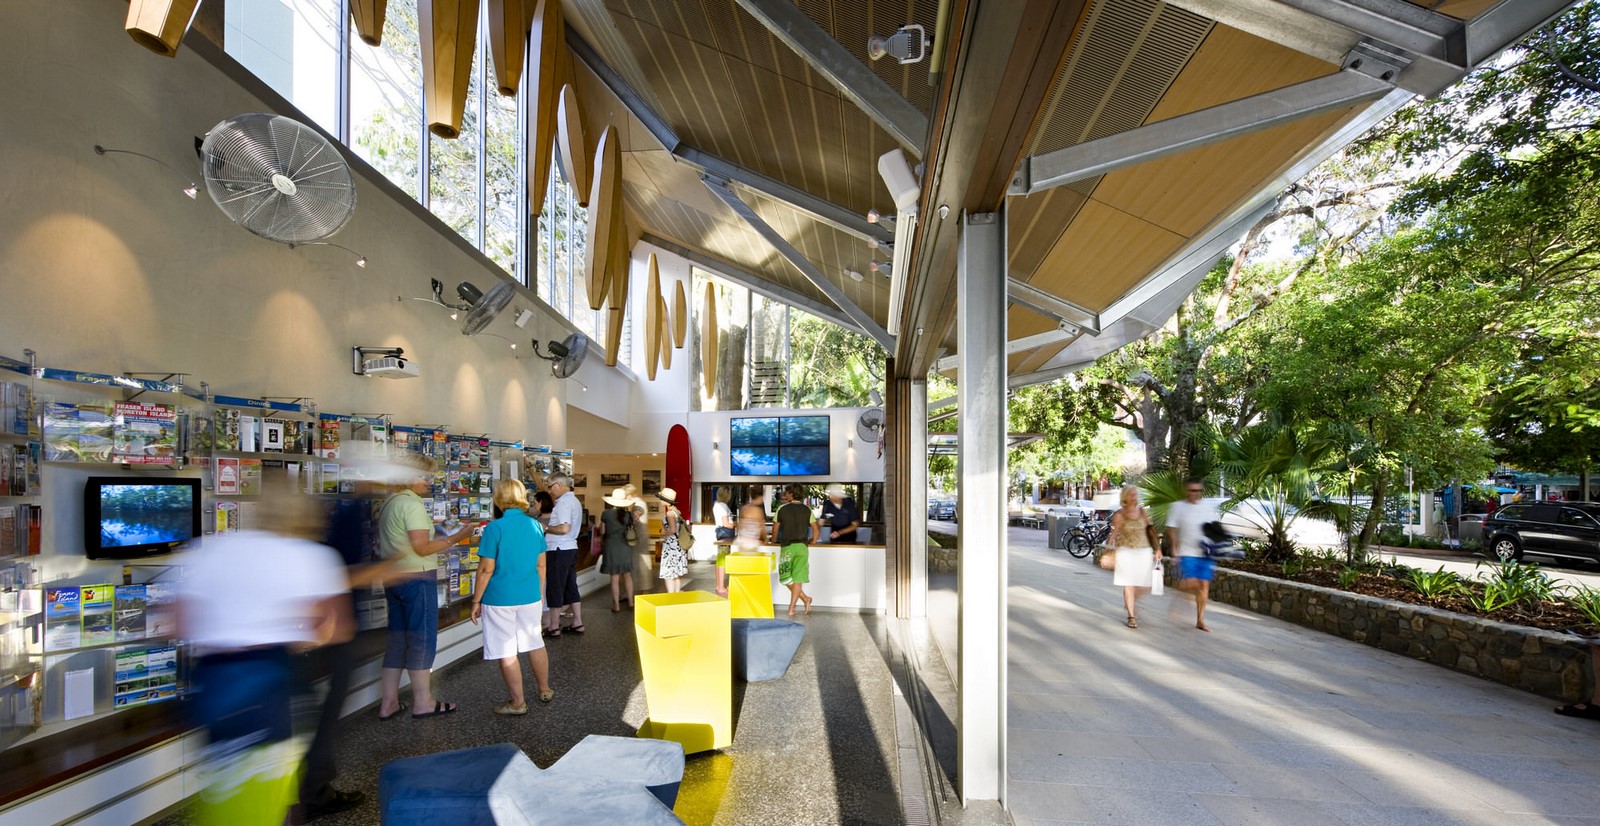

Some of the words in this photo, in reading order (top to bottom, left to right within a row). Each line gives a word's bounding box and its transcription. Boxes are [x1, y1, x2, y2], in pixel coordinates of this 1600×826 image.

[76, 374, 109, 383] Fraser
[114, 378, 144, 388] Isd
[248, 399, 271, 408] Dining
